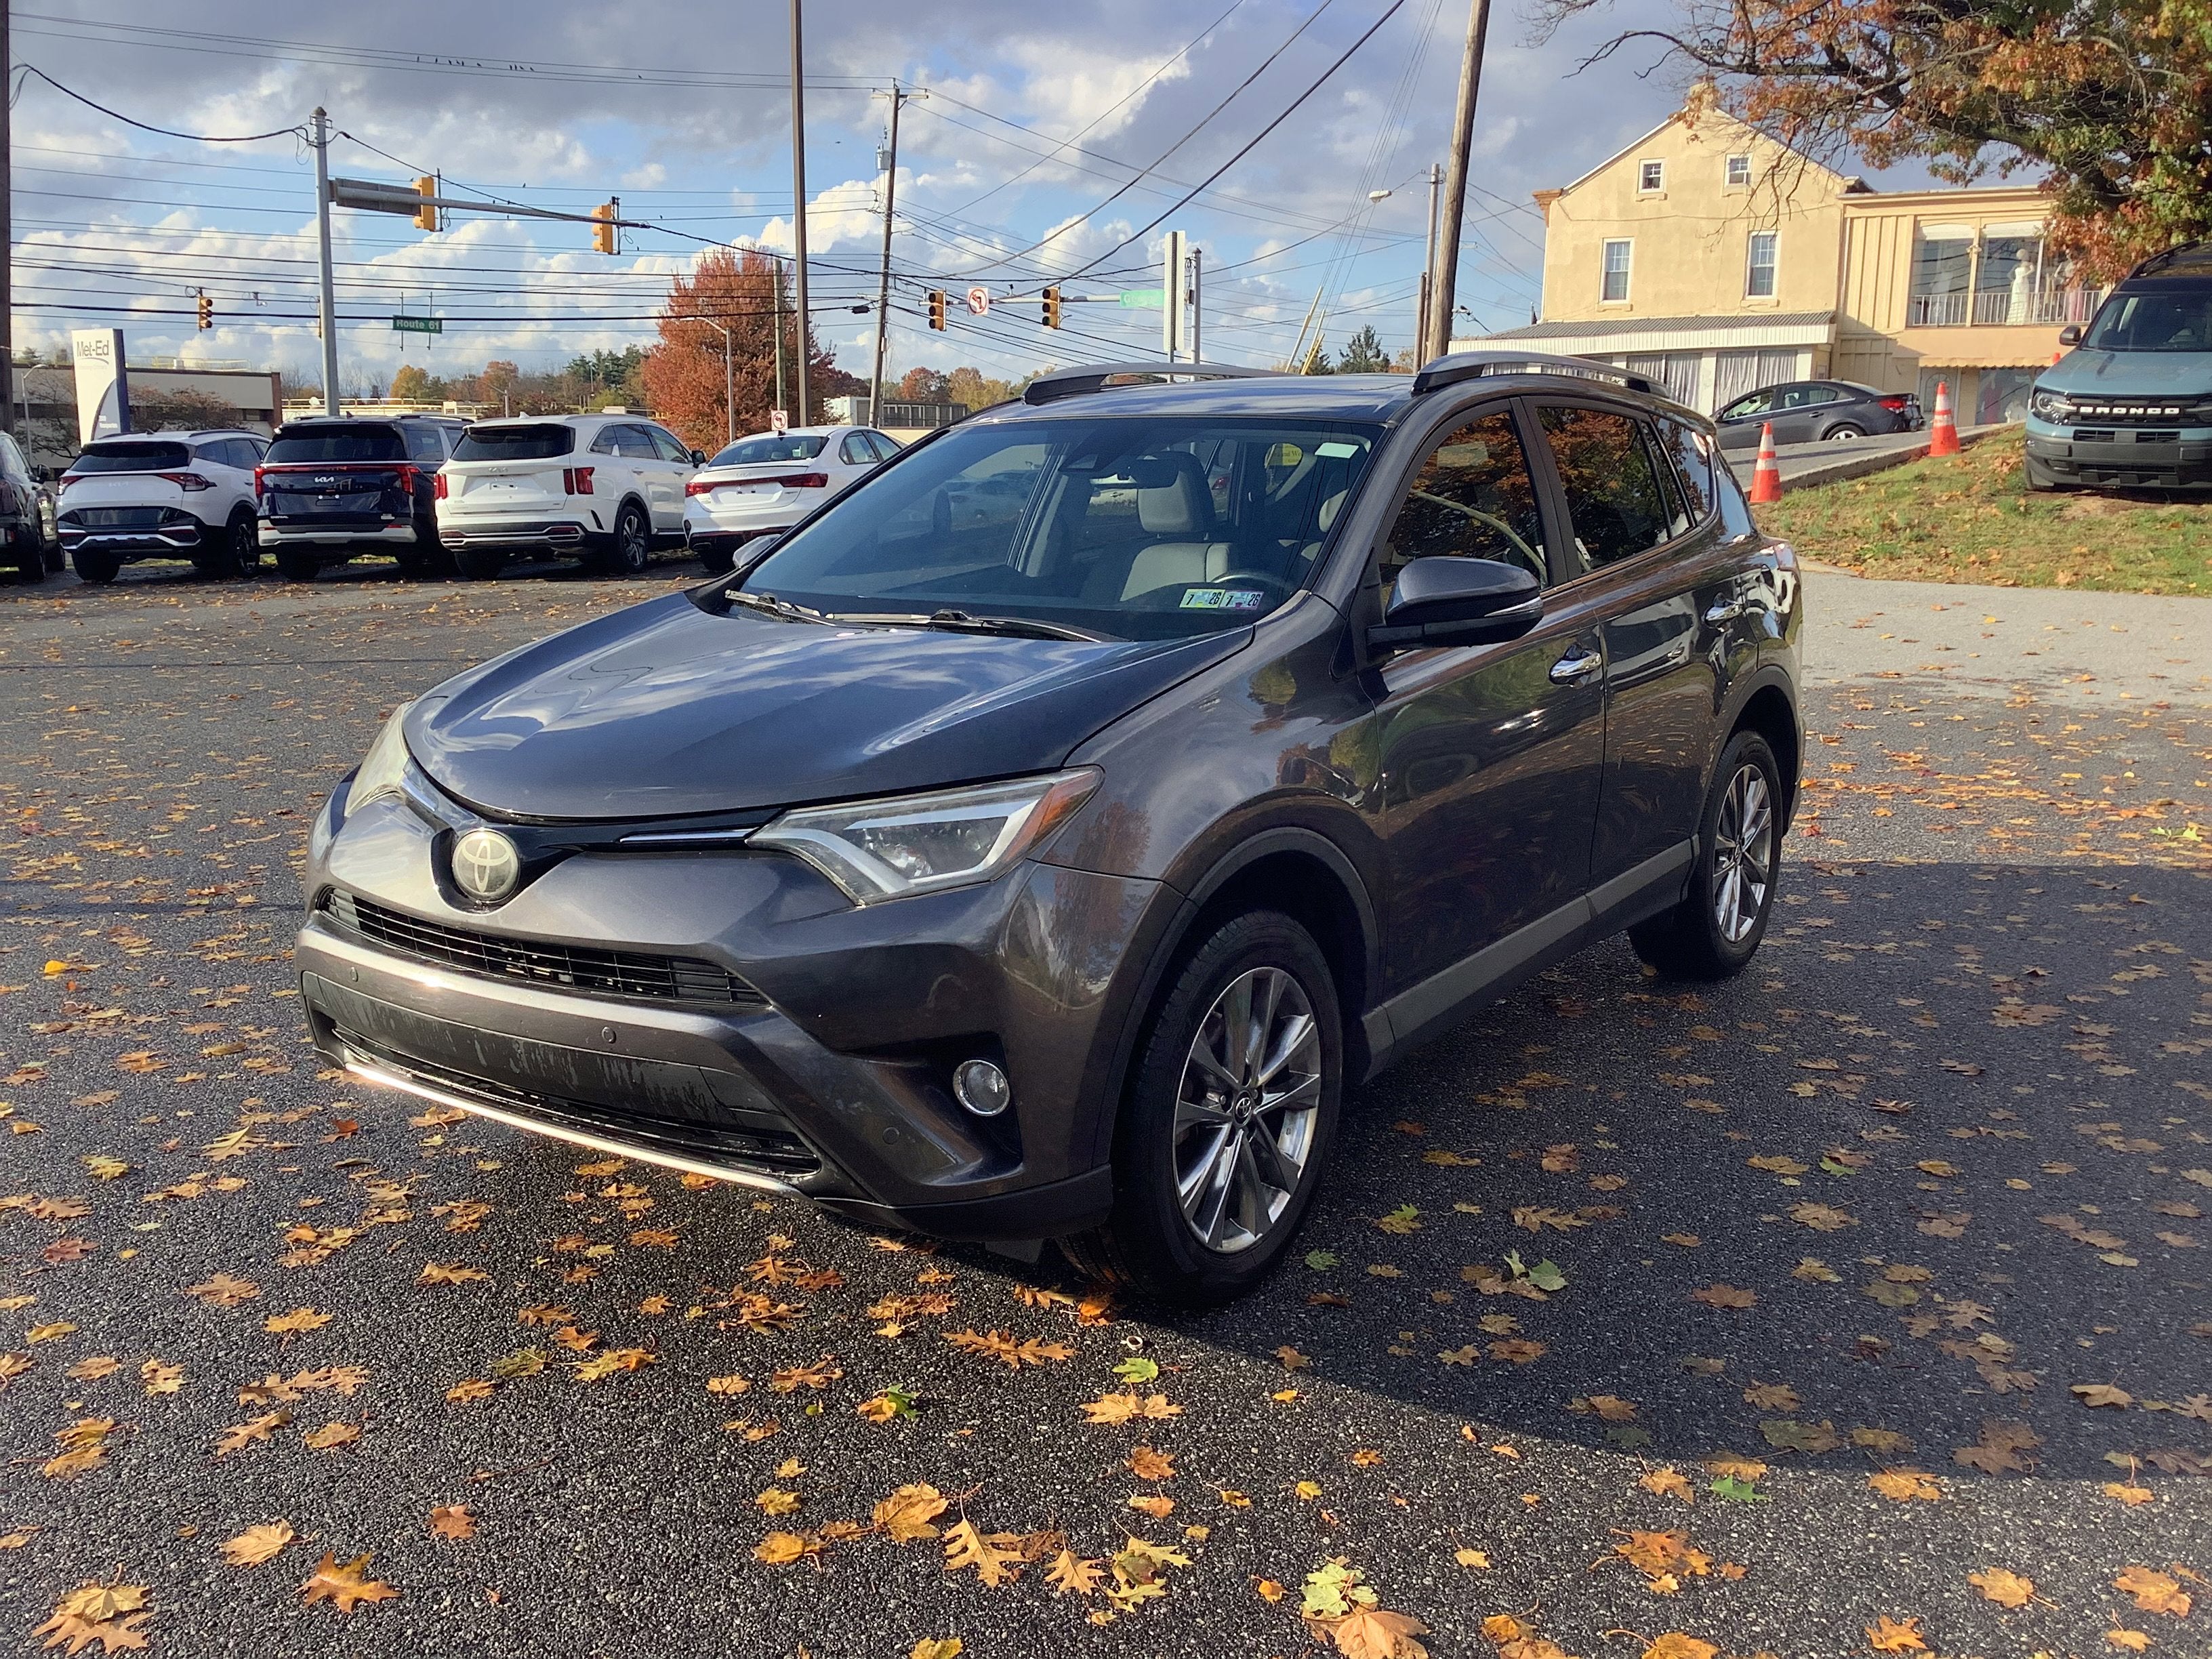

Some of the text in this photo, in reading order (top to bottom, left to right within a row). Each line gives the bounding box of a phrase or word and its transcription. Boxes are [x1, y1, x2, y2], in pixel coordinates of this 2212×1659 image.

[396, 319, 440, 330] Route 61
[77, 340, 109, 357] Met-Ed
[2079, 406, 2180, 415] BRONCO
[1186, 592, 1221, 606] 7 26
[1225, 594, 1261, 607] 7 26
